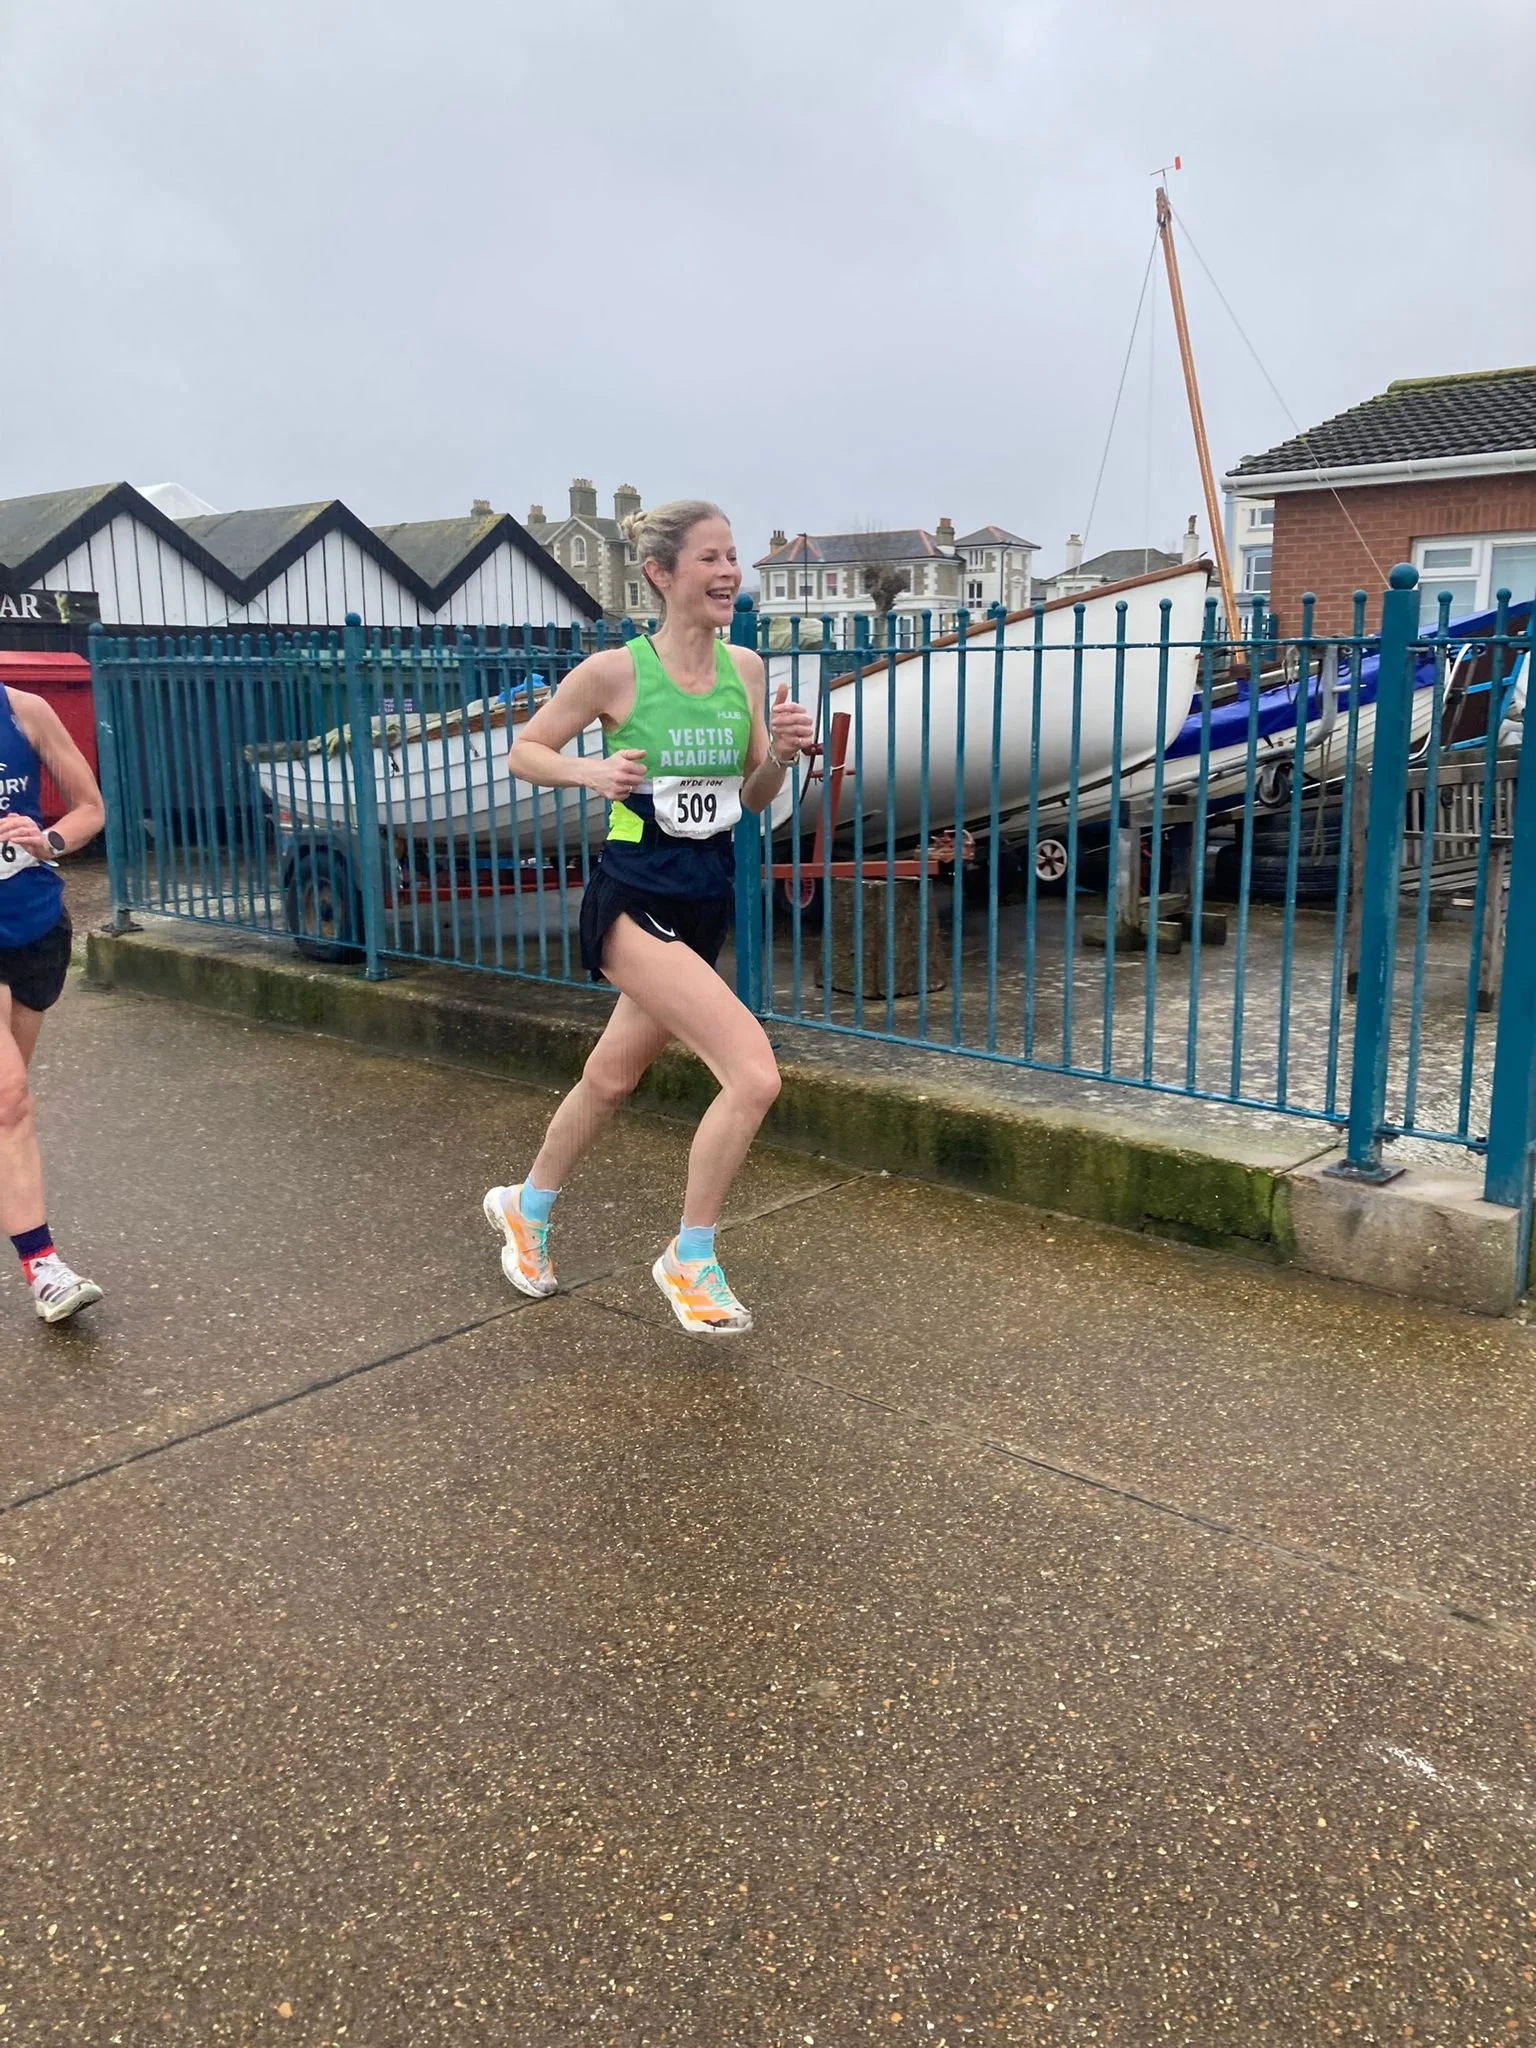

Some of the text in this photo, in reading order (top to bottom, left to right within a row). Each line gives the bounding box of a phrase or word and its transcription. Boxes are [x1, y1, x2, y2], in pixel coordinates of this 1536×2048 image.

[668, 728, 733, 745] VECTIS
[661, 750, 740, 766] ACADEMY
[677, 793, 717, 823] 509
